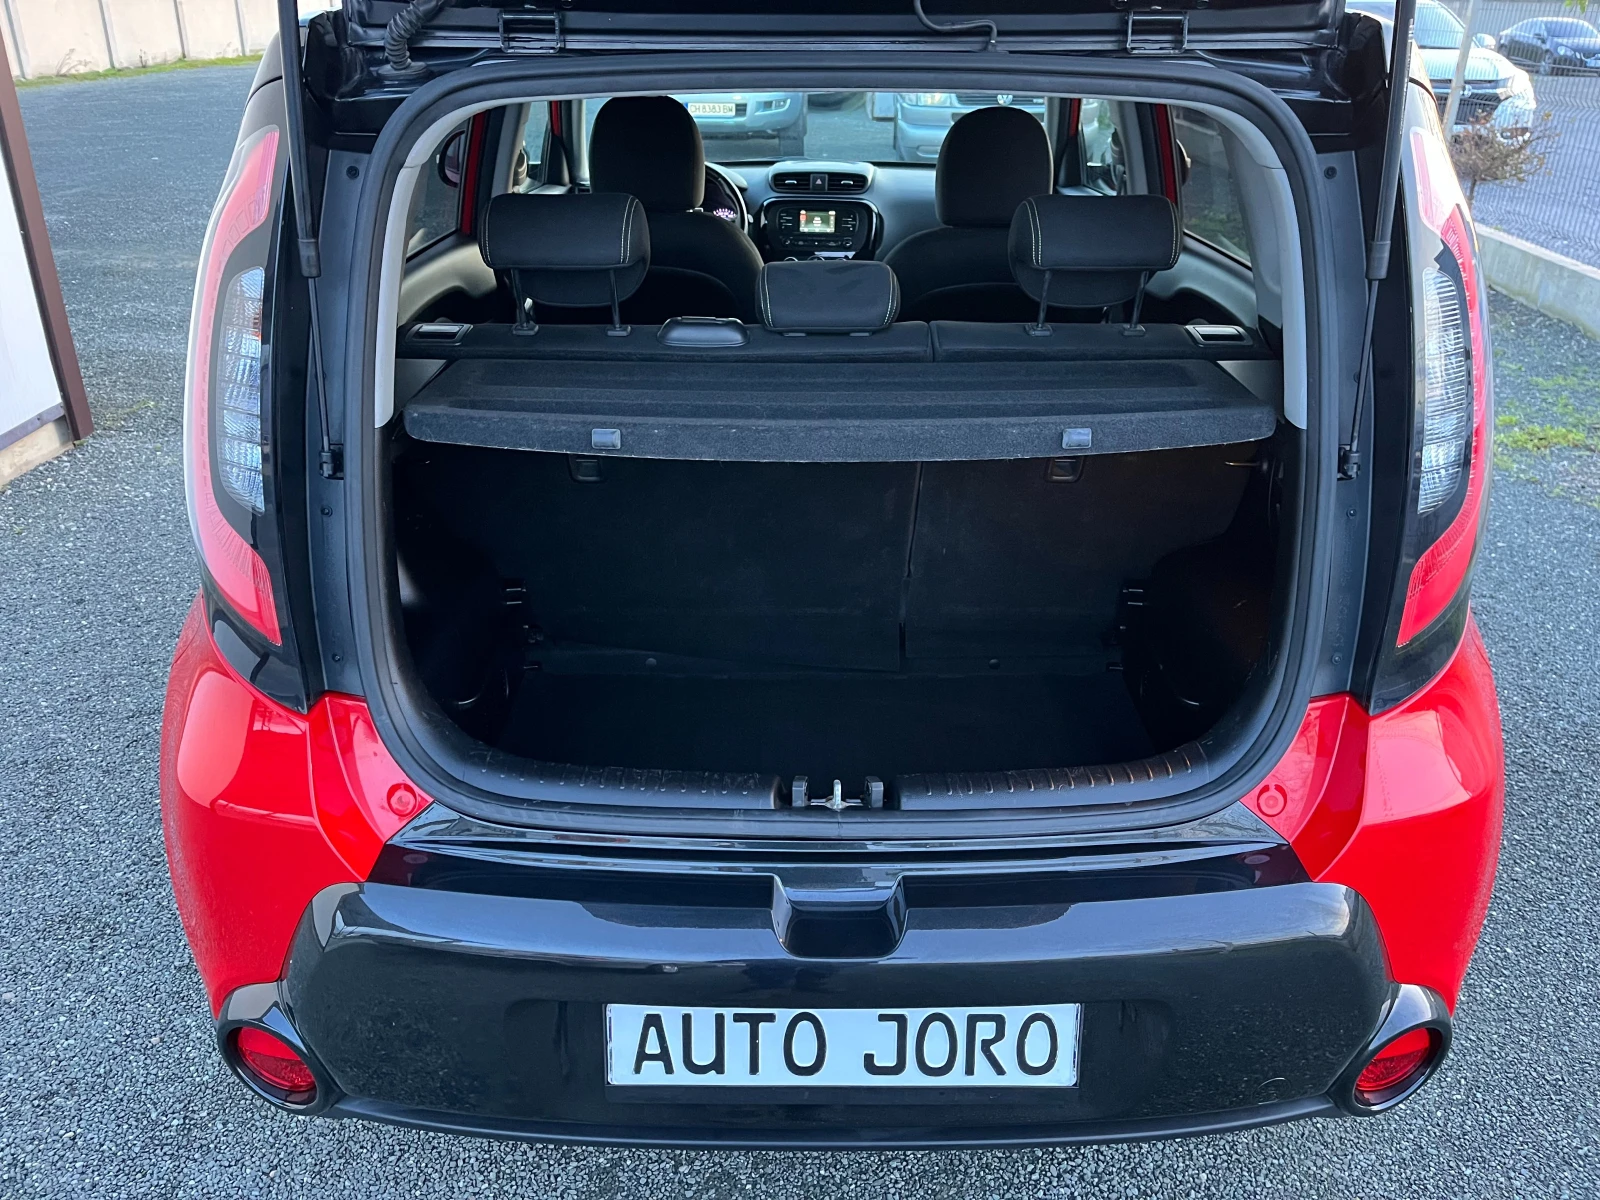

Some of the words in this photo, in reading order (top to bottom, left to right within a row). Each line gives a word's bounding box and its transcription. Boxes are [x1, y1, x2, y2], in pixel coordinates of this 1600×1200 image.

[701, 104, 721, 113] 8383
[632, 1012, 827, 1077] AUTO
[862, 1012, 1058, 1077] JORO
